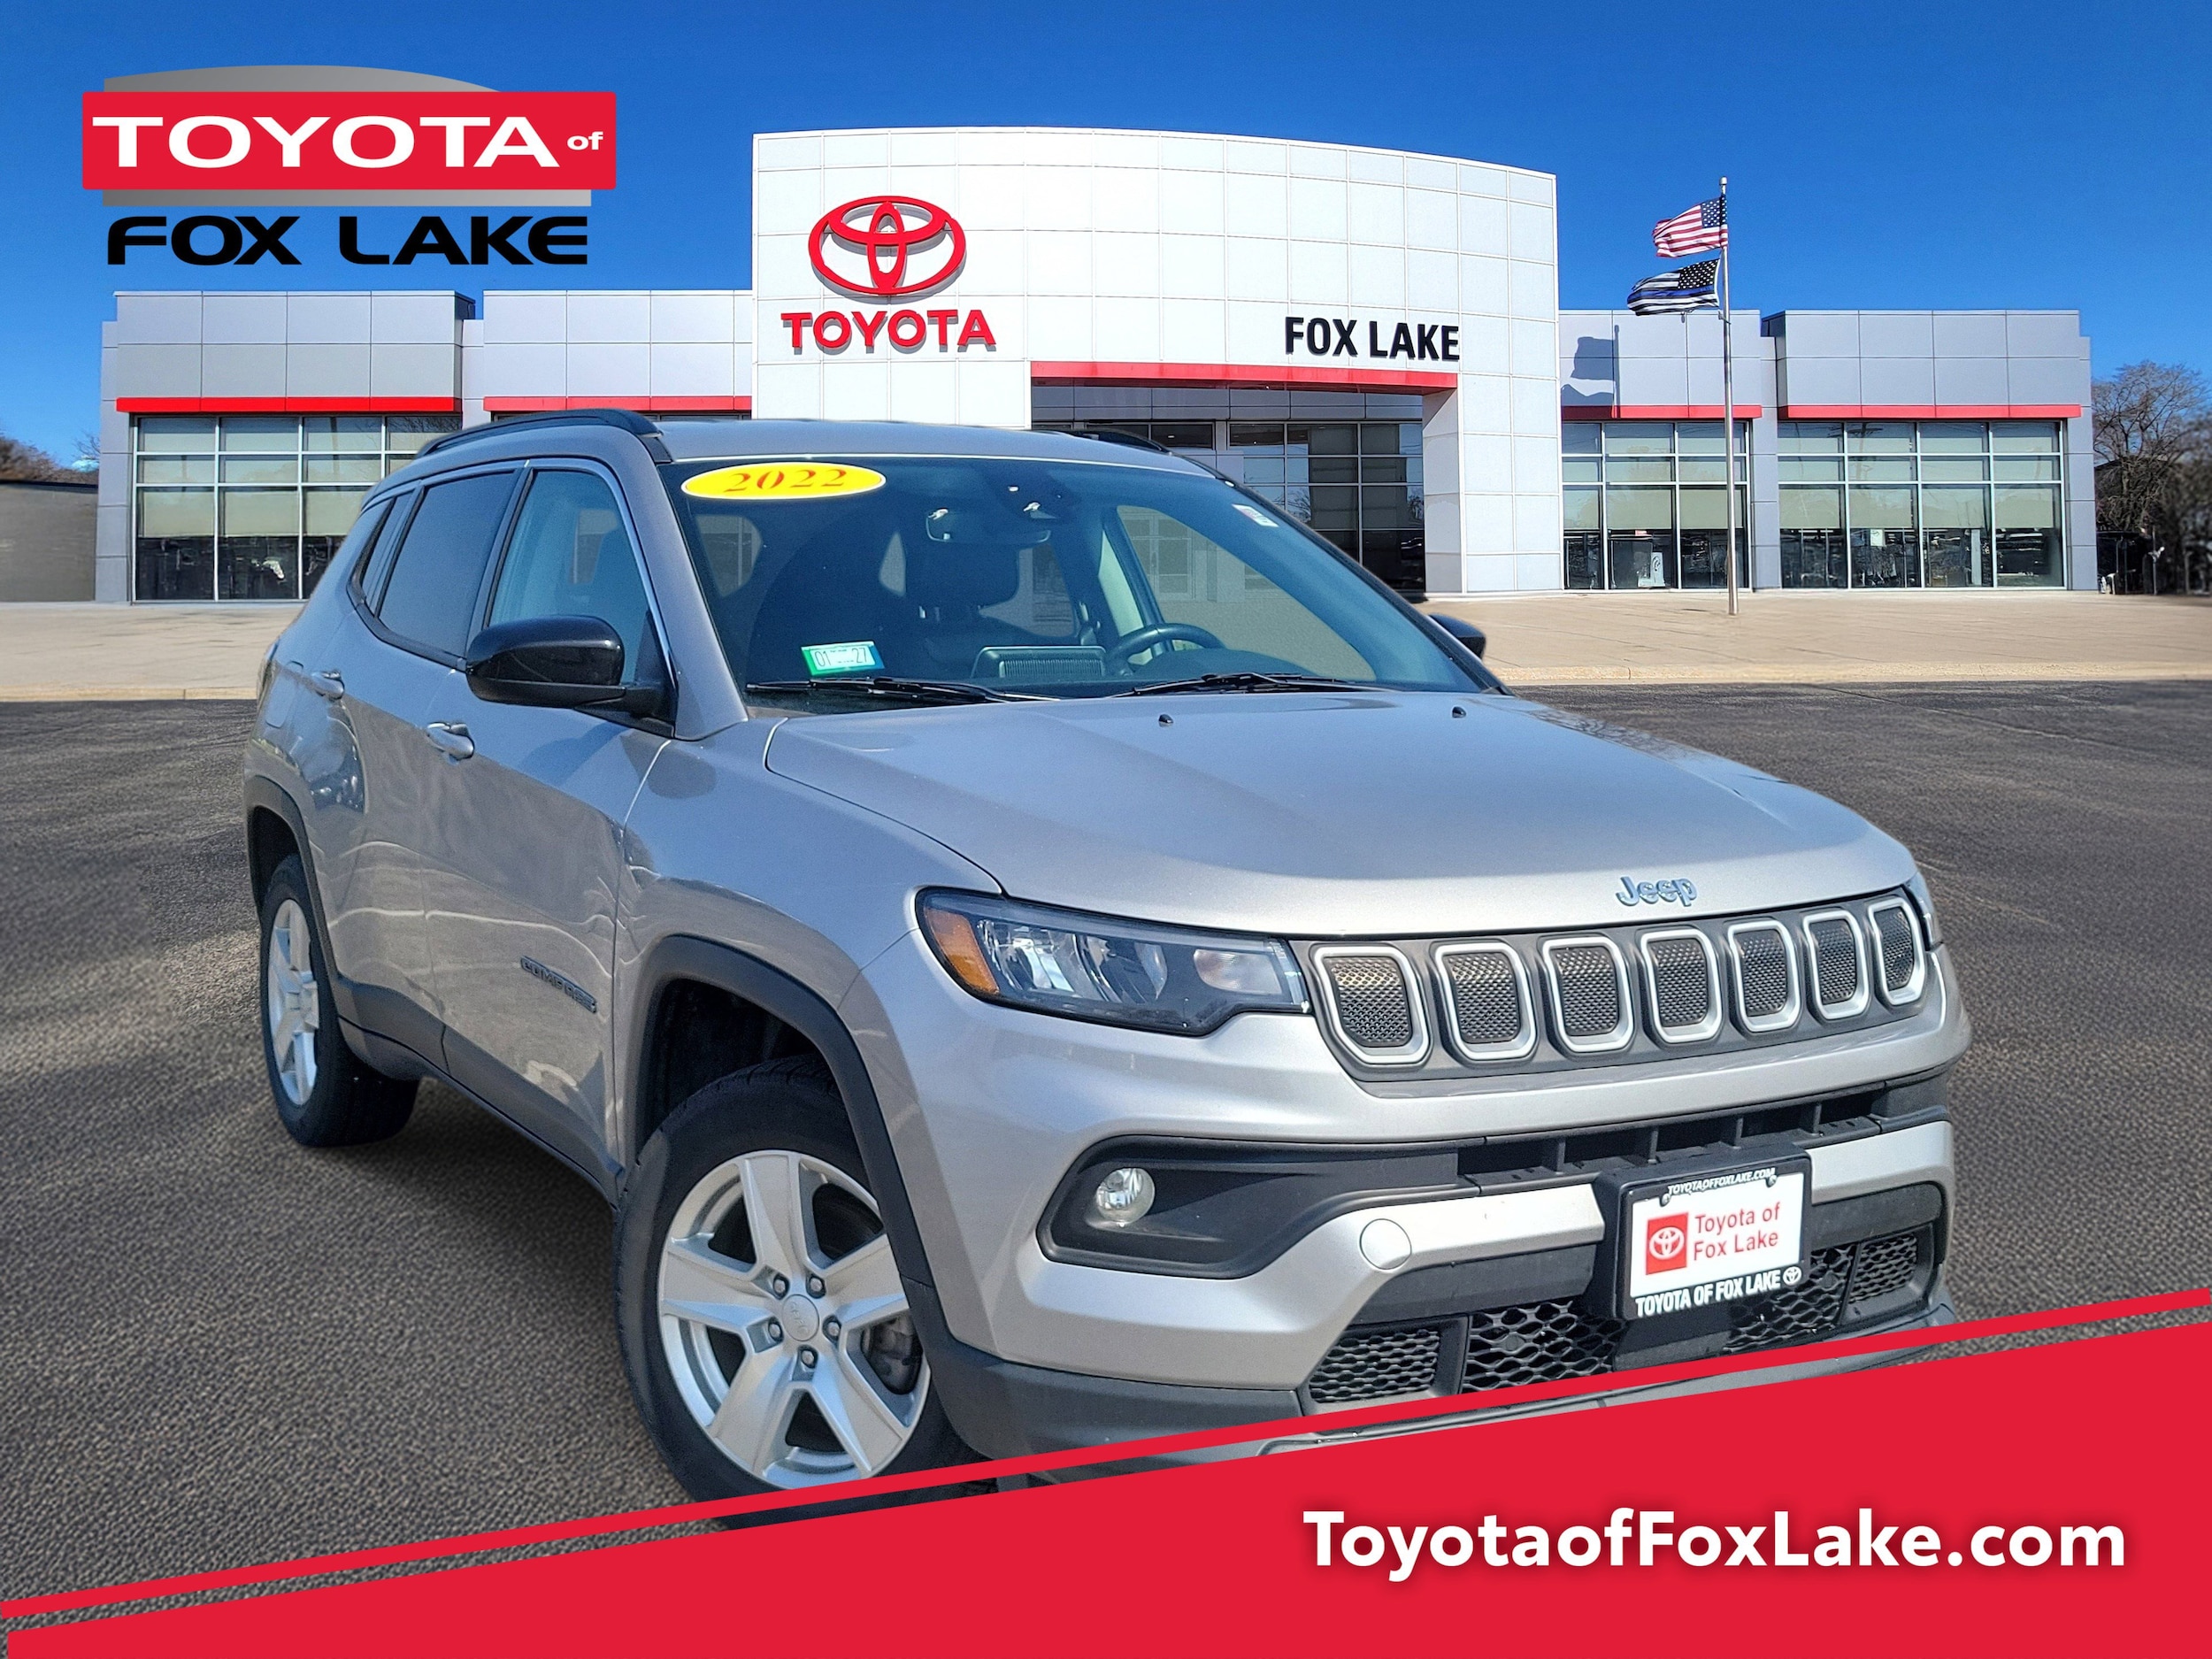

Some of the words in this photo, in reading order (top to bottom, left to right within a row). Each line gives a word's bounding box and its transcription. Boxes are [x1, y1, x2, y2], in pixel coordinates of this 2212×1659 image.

[780, 310, 996, 355] TOYOTA
[1285, 316, 1358, 357] FOX
[1369, 320, 1460, 361] LAKE
[723, 469, 847, 492] 2022
[814, 650, 832, 667] 01
[851, 647, 868, 664] 27
[1615, 875, 1698, 907] Jeep
[1668, 1168, 1776, 1194] TOYOTAOFFOXLAKE.COM
[1695, 1210, 1755, 1235] Toyota
[1763, 1202, 1780, 1221] of
[1694, 1240, 1726, 1261] Fox
[1734, 1230, 1778, 1252] Lake
[1636, 1289, 1691, 1317] TOYOTA
[1694, 1283, 1714, 1305] OF
[1715, 1278, 1745, 1302] FOX
[1747, 1270, 1780, 1293] LAKE
